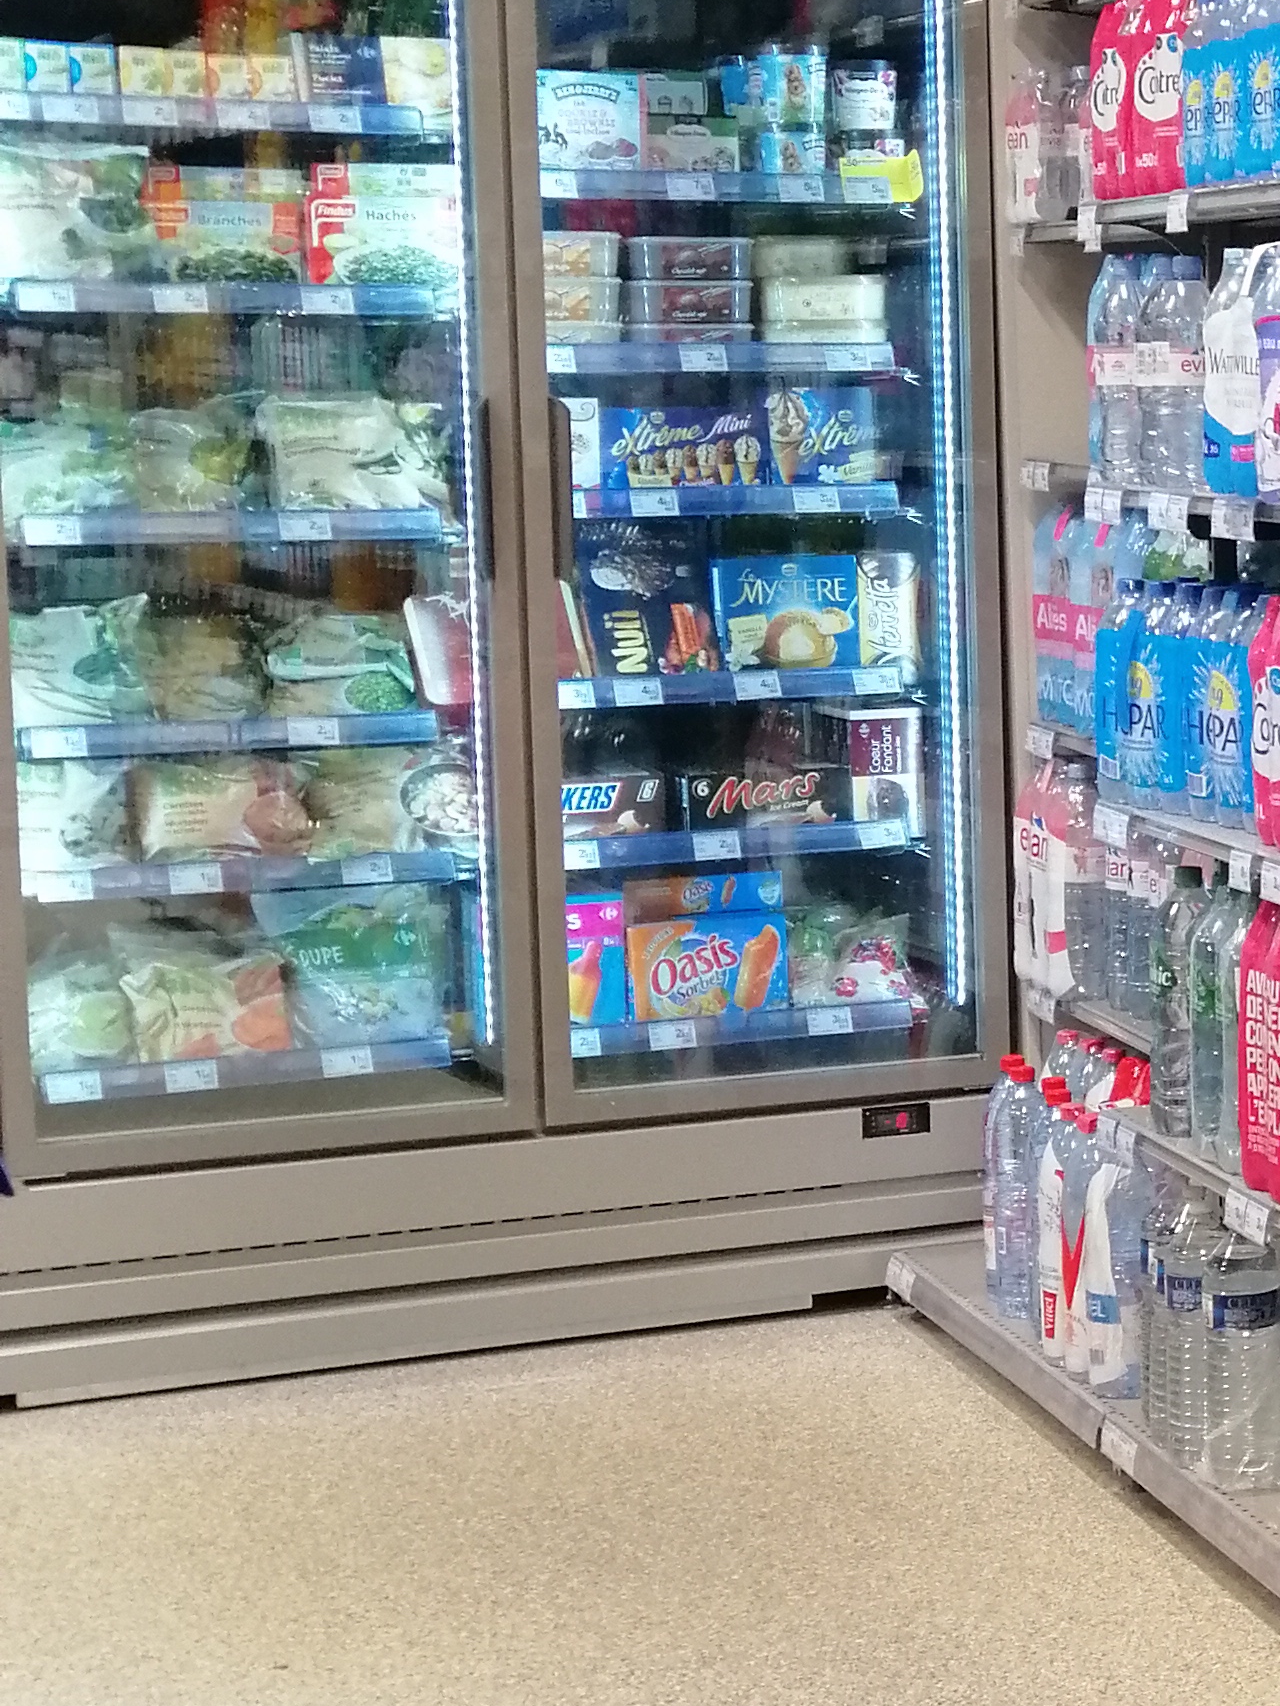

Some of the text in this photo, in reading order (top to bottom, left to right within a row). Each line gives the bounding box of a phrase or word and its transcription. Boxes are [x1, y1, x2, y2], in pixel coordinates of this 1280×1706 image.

[366, 208, 416, 223] Hachés
[739, 570, 847, 606] MYSTÈRE
[881, 725, 892, 773] Fondant
[708, 772, 819, 819] Mars
[650, 933, 739, 997] Oasis
